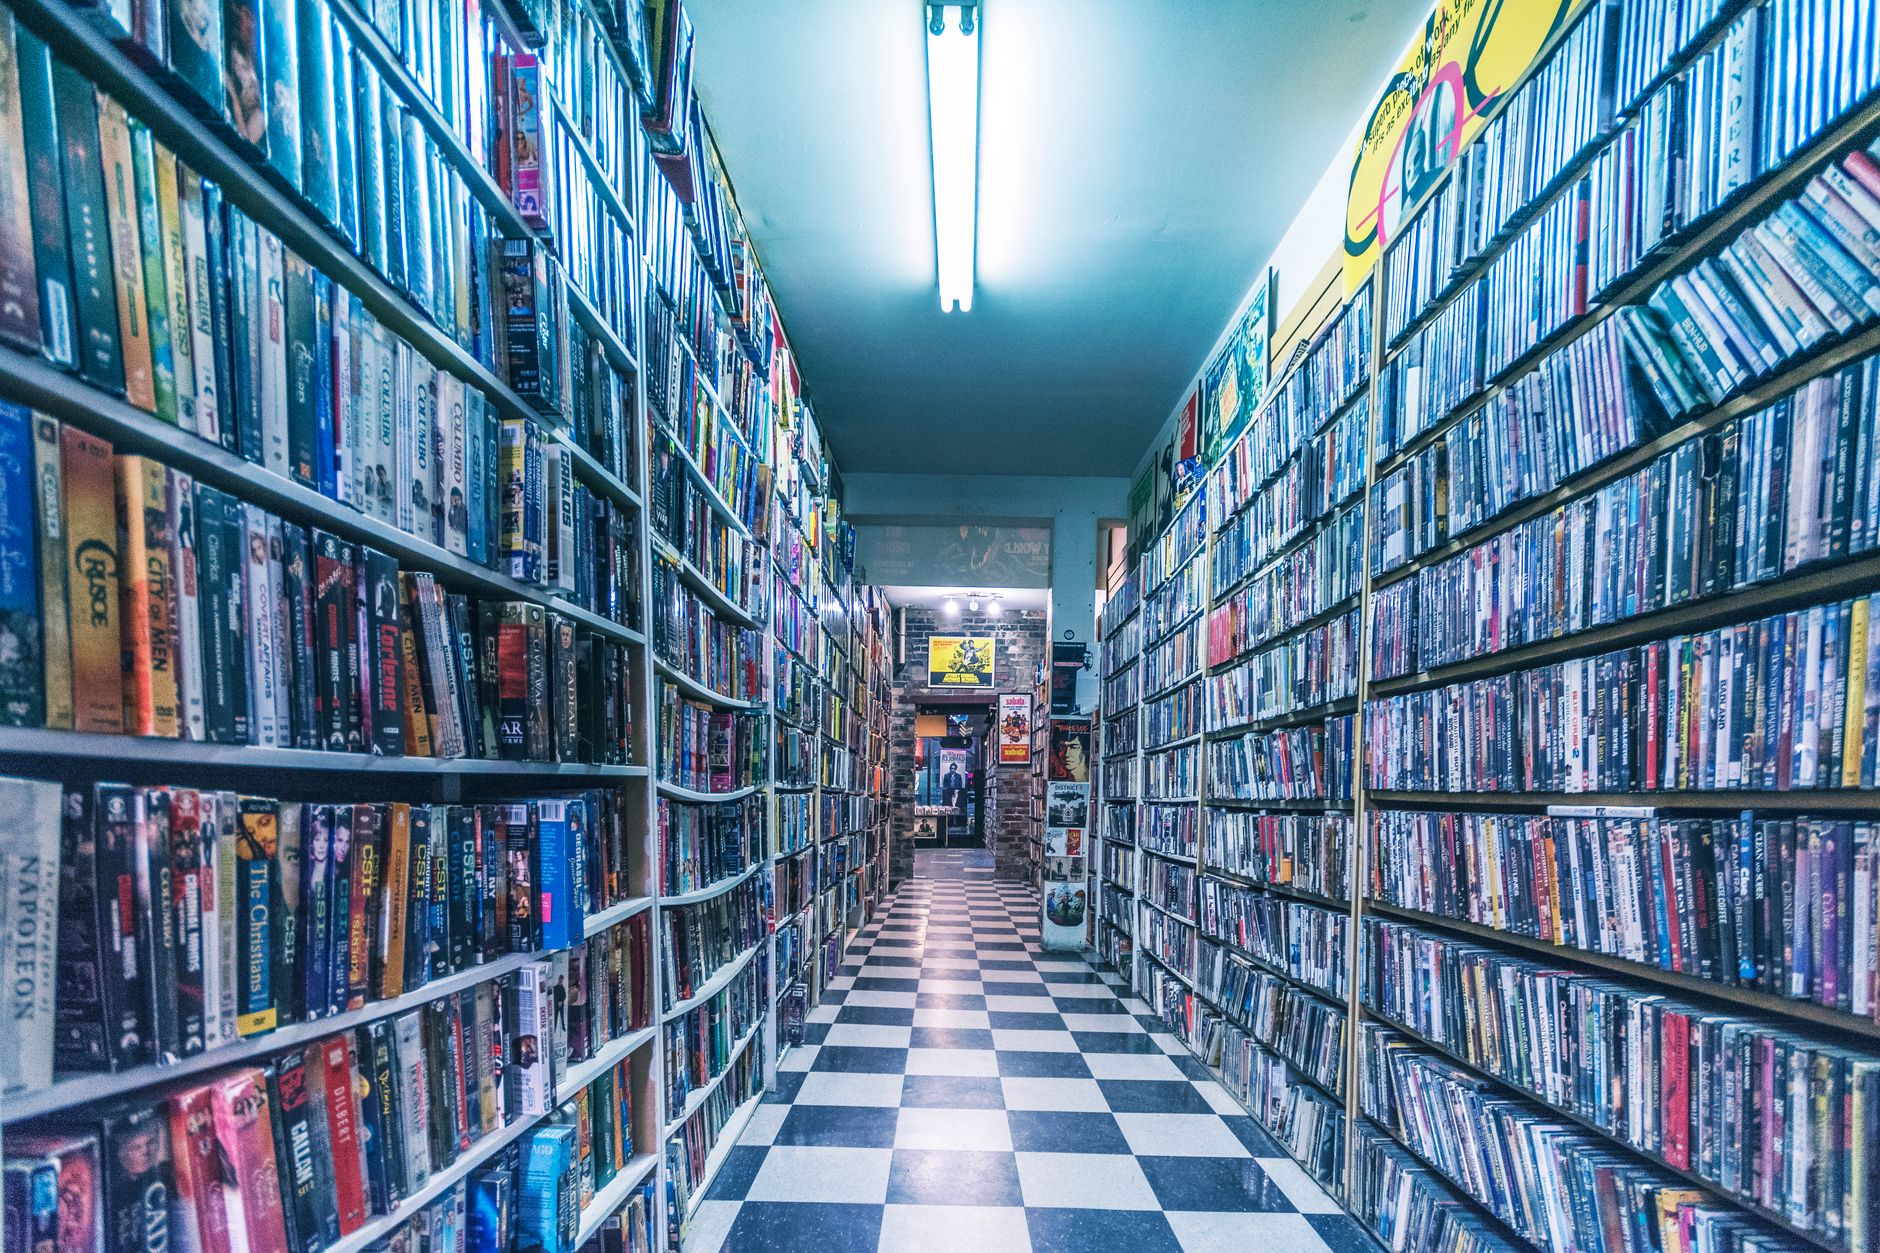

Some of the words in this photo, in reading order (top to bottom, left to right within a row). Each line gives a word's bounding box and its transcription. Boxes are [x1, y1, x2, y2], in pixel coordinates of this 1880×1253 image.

[1367, 100, 1390, 145] superb
[1392, 66, 1416, 109] piece
[1416, 48, 1427, 70] of
[1386, 119, 1395, 136] as
[1430, 48, 1442, 68] as
[1443, 17, 1460, 49] any
[1682, 318, 1708, 352] BEN-HUR
[381, 369, 391, 446] COLUMBO
[417, 383, 427, 470] COLUMBO
[453, 402, 463, 484] COLUMBO
[488, 439, 497, 488] CSI:
[525, 450, 533, 505] COMMUNITY
[560, 451, 572, 528] CARLOS
[76, 539, 119, 627] CRUSOE
[148, 557, 165, 598] CITY
[259, 583, 269, 640] COVERT
[295, 595, 305, 663] COLUMBO
[151, 627, 168, 672] MEN
[262, 644, 272, 700] AFFAIRS
[330, 650, 339, 682] MINDS
[349, 643, 357, 677] MINDS
[381, 624, 398, 712] Corleone
[461, 632, 475, 681] CSI:
[533, 639, 541, 675] CIVIL
[404, 637, 417, 665] CITY
[411, 684, 422, 714] MEN
[534, 678, 542, 706] WAR
[1836, 677, 1846, 695] THE
[567, 661, 576, 742] CADFAEL
[1718, 679, 1728, 730] BADLAND
[1834, 695, 1844, 727] BROWN
[1573, 748, 1579, 759] 2
[1832, 727, 1841, 758] BUNNY
[362, 844, 373, 897] CSI:
[417, 843, 426, 898] CSI:
[463, 840, 475, 886] CSI:
[1593, 846, 1601, 883] COUNTRY
[1730, 844, 1740, 892] CAMERA
[1755, 832, 1763, 860] CLEAN
[250, 864, 268, 899] The
[436, 856, 446, 902] CSI:
[1510, 847, 1519, 896] COASTLINES
[1626, 855, 1637, 923] CROSSROADS
[1684, 863, 1694, 910] CHANGELING
[1717, 872, 1725, 897] CHINESE
[1740, 867, 1749, 896] Clue
[1755, 874, 1763, 900] SOBER
[160, 867, 172, 948] COLUMBO
[185, 874, 198, 931] CRIMINAL
[1596, 883, 1604, 915] STRONG
[1717, 898, 1727, 924] COFFEE
[14, 854, 39, 1023] NAPOLEON
[250, 904, 269, 993] Christians
[283, 916, 295, 965] CSI:
[334, 1086, 351, 1145] DILBERT
[291, 1120, 313, 1184] CALLAN
